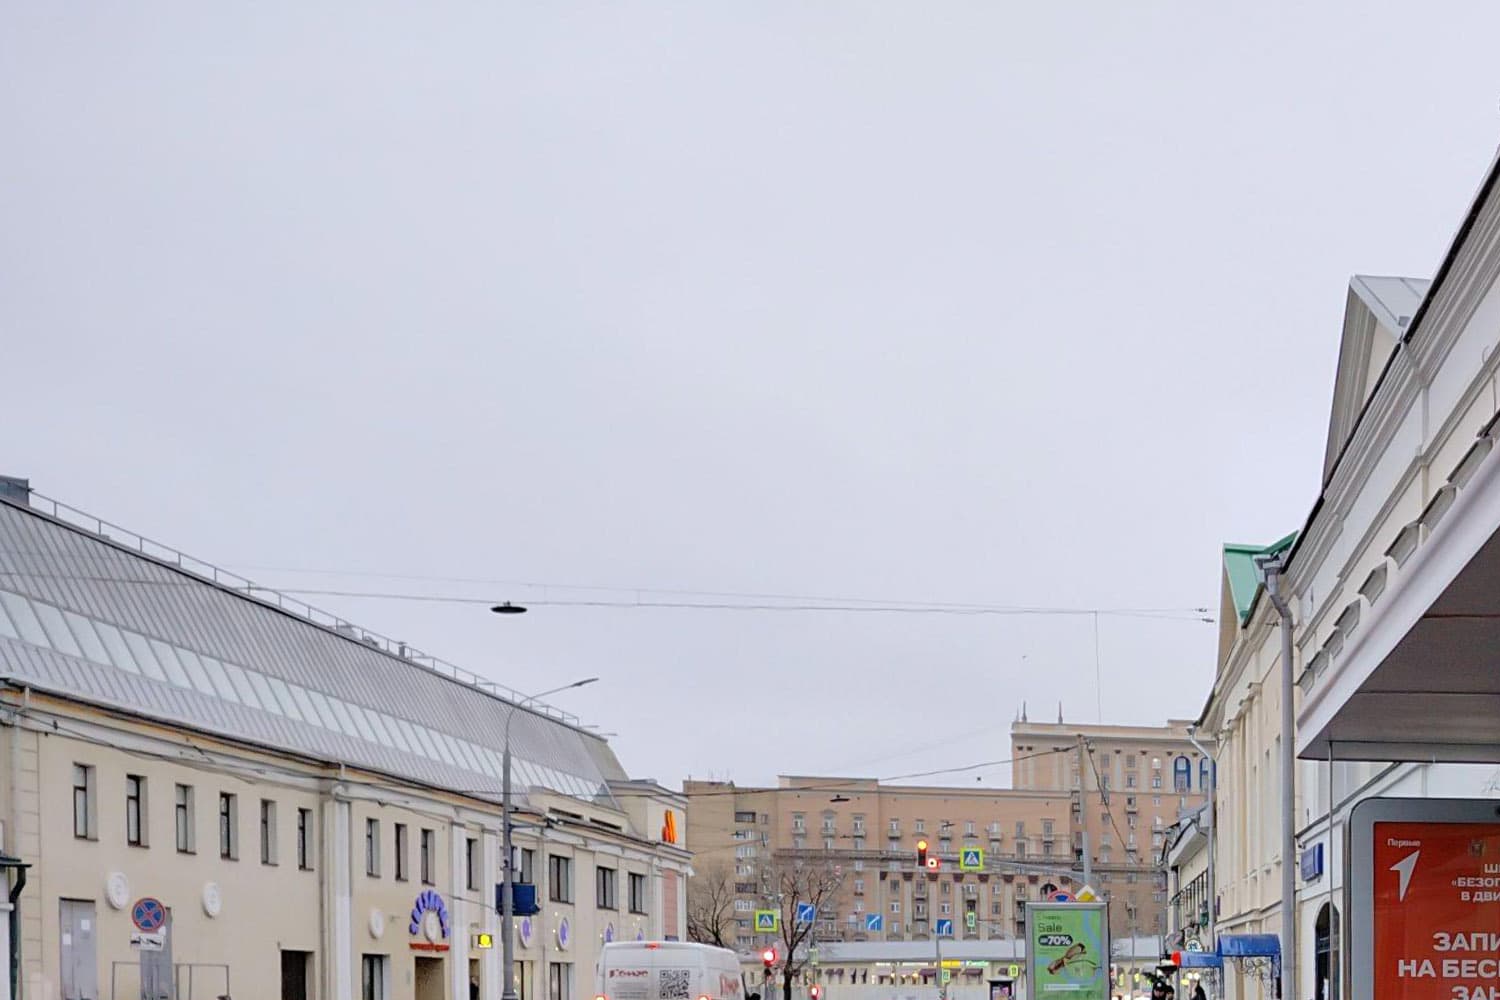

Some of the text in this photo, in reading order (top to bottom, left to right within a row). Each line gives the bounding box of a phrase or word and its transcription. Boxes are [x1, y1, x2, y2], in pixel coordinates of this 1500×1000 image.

[1461, 891, 1470, 901] В
[1038, 922, 1063, 932] Sale
[1398, 959, 1436, 978] НА
